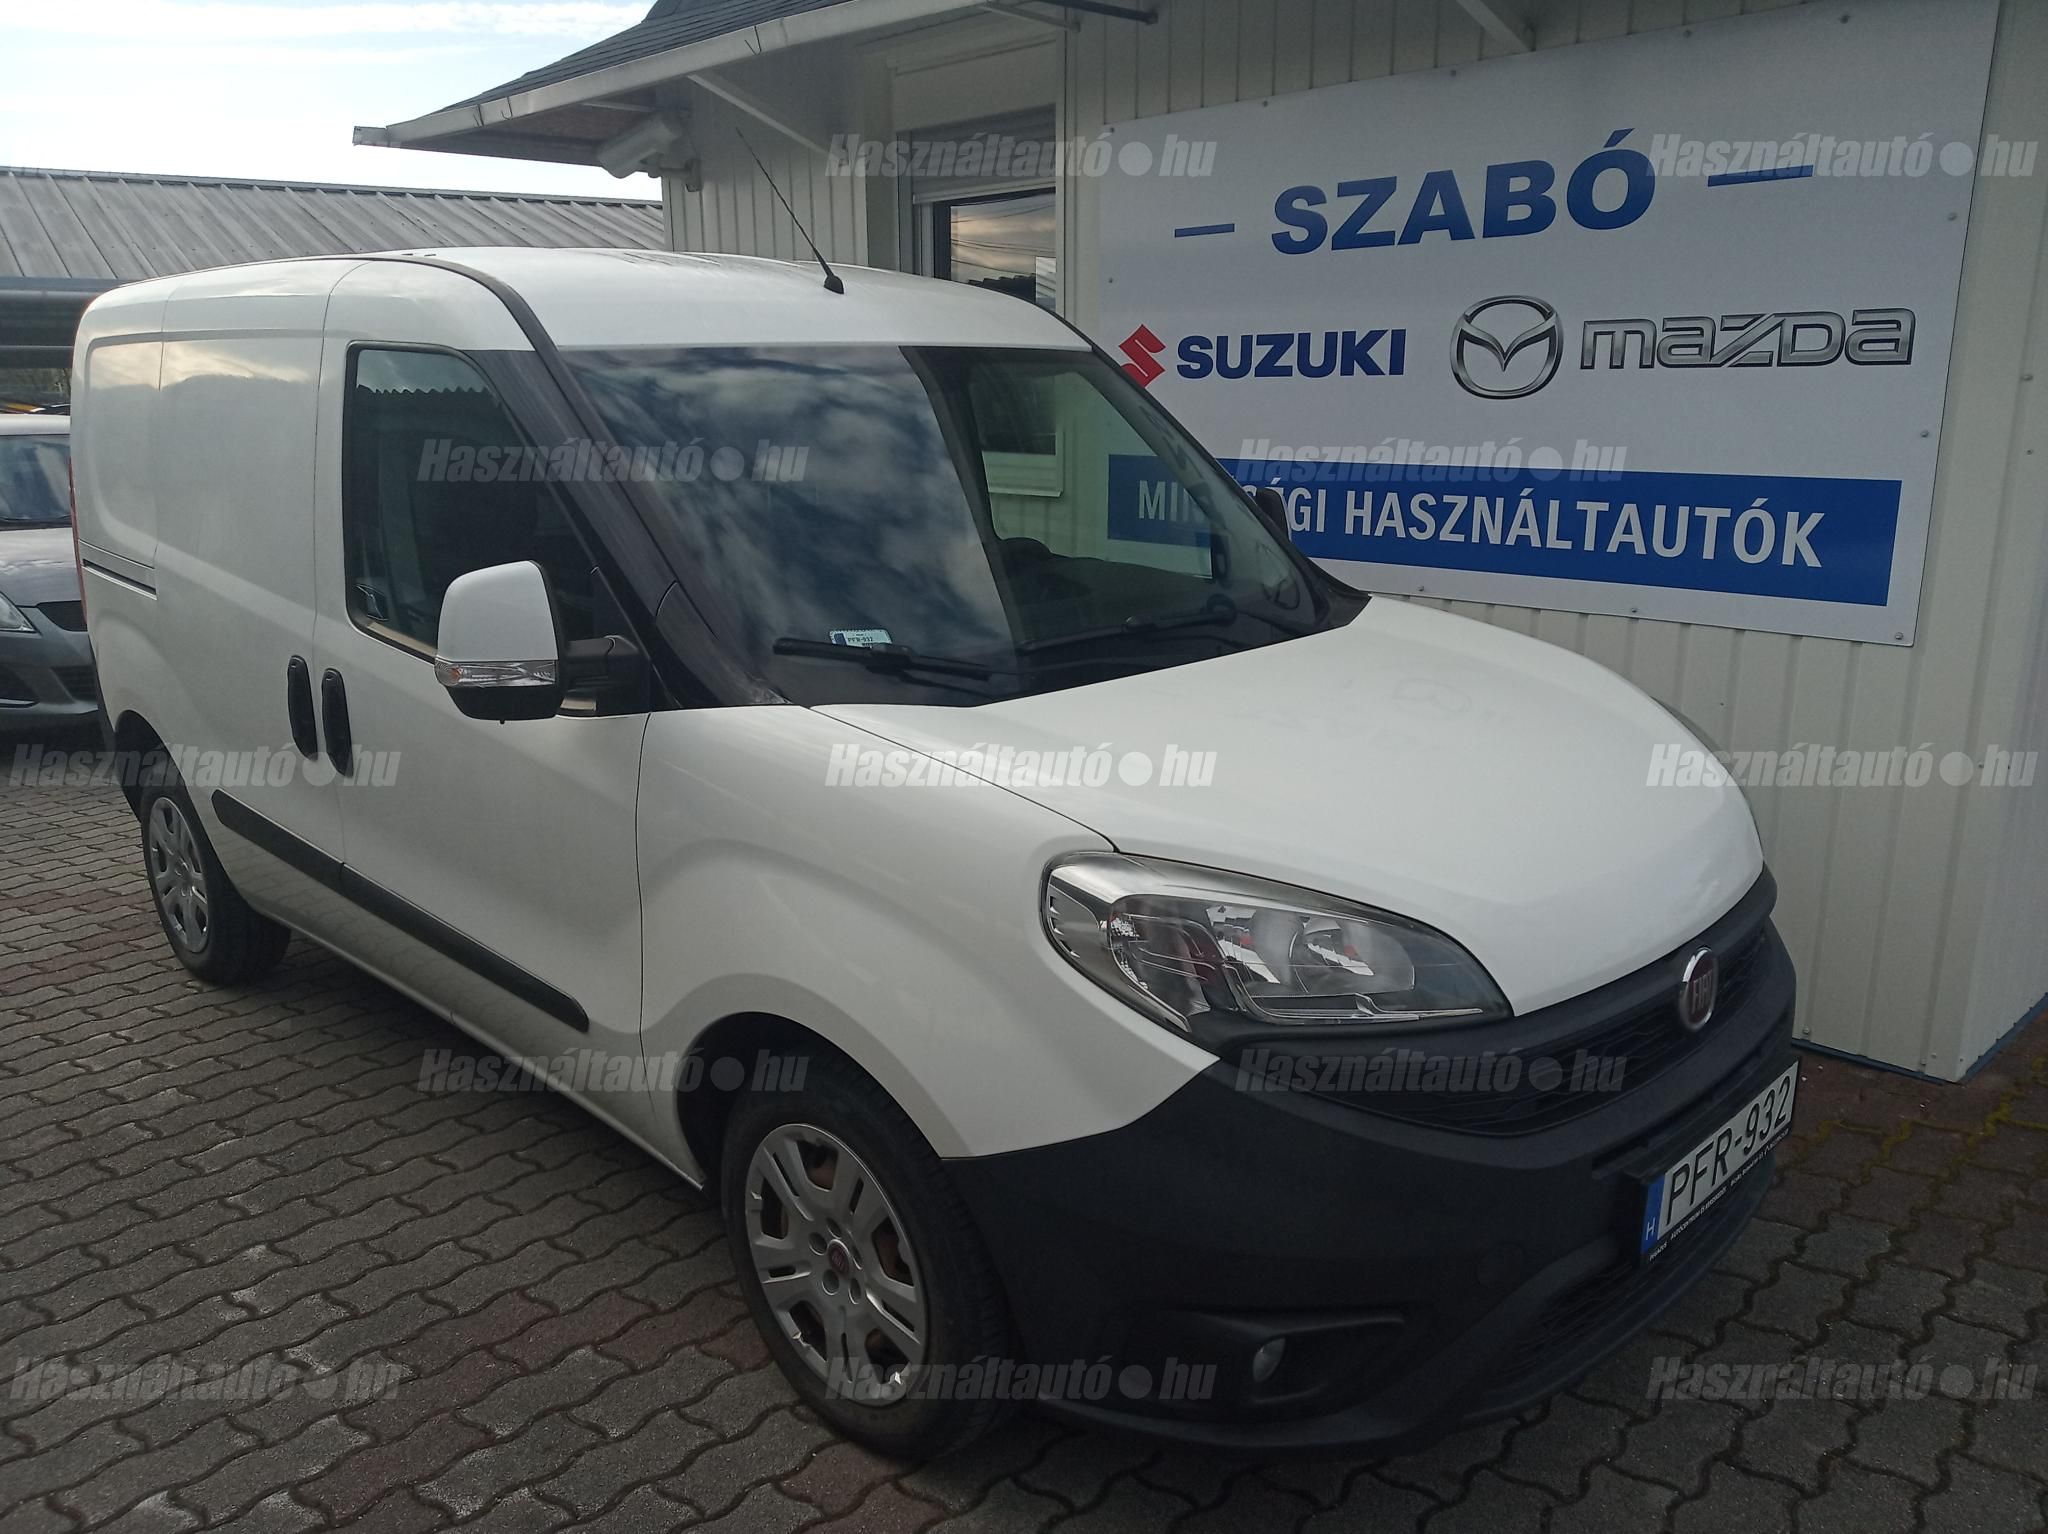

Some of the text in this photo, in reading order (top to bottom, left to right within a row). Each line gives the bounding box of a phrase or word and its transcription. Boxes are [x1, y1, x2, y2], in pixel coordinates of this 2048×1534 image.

[1271, 128, 1657, 255] SZABÓ
[1177, 328, 1406, 380] SUZUKI
[1345, 487, 1825, 569] HASZNÁLTAUTÓK
[1645, 1217, 1656, 1241] H
[1666, 1075, 1791, 1226] PFR-932
